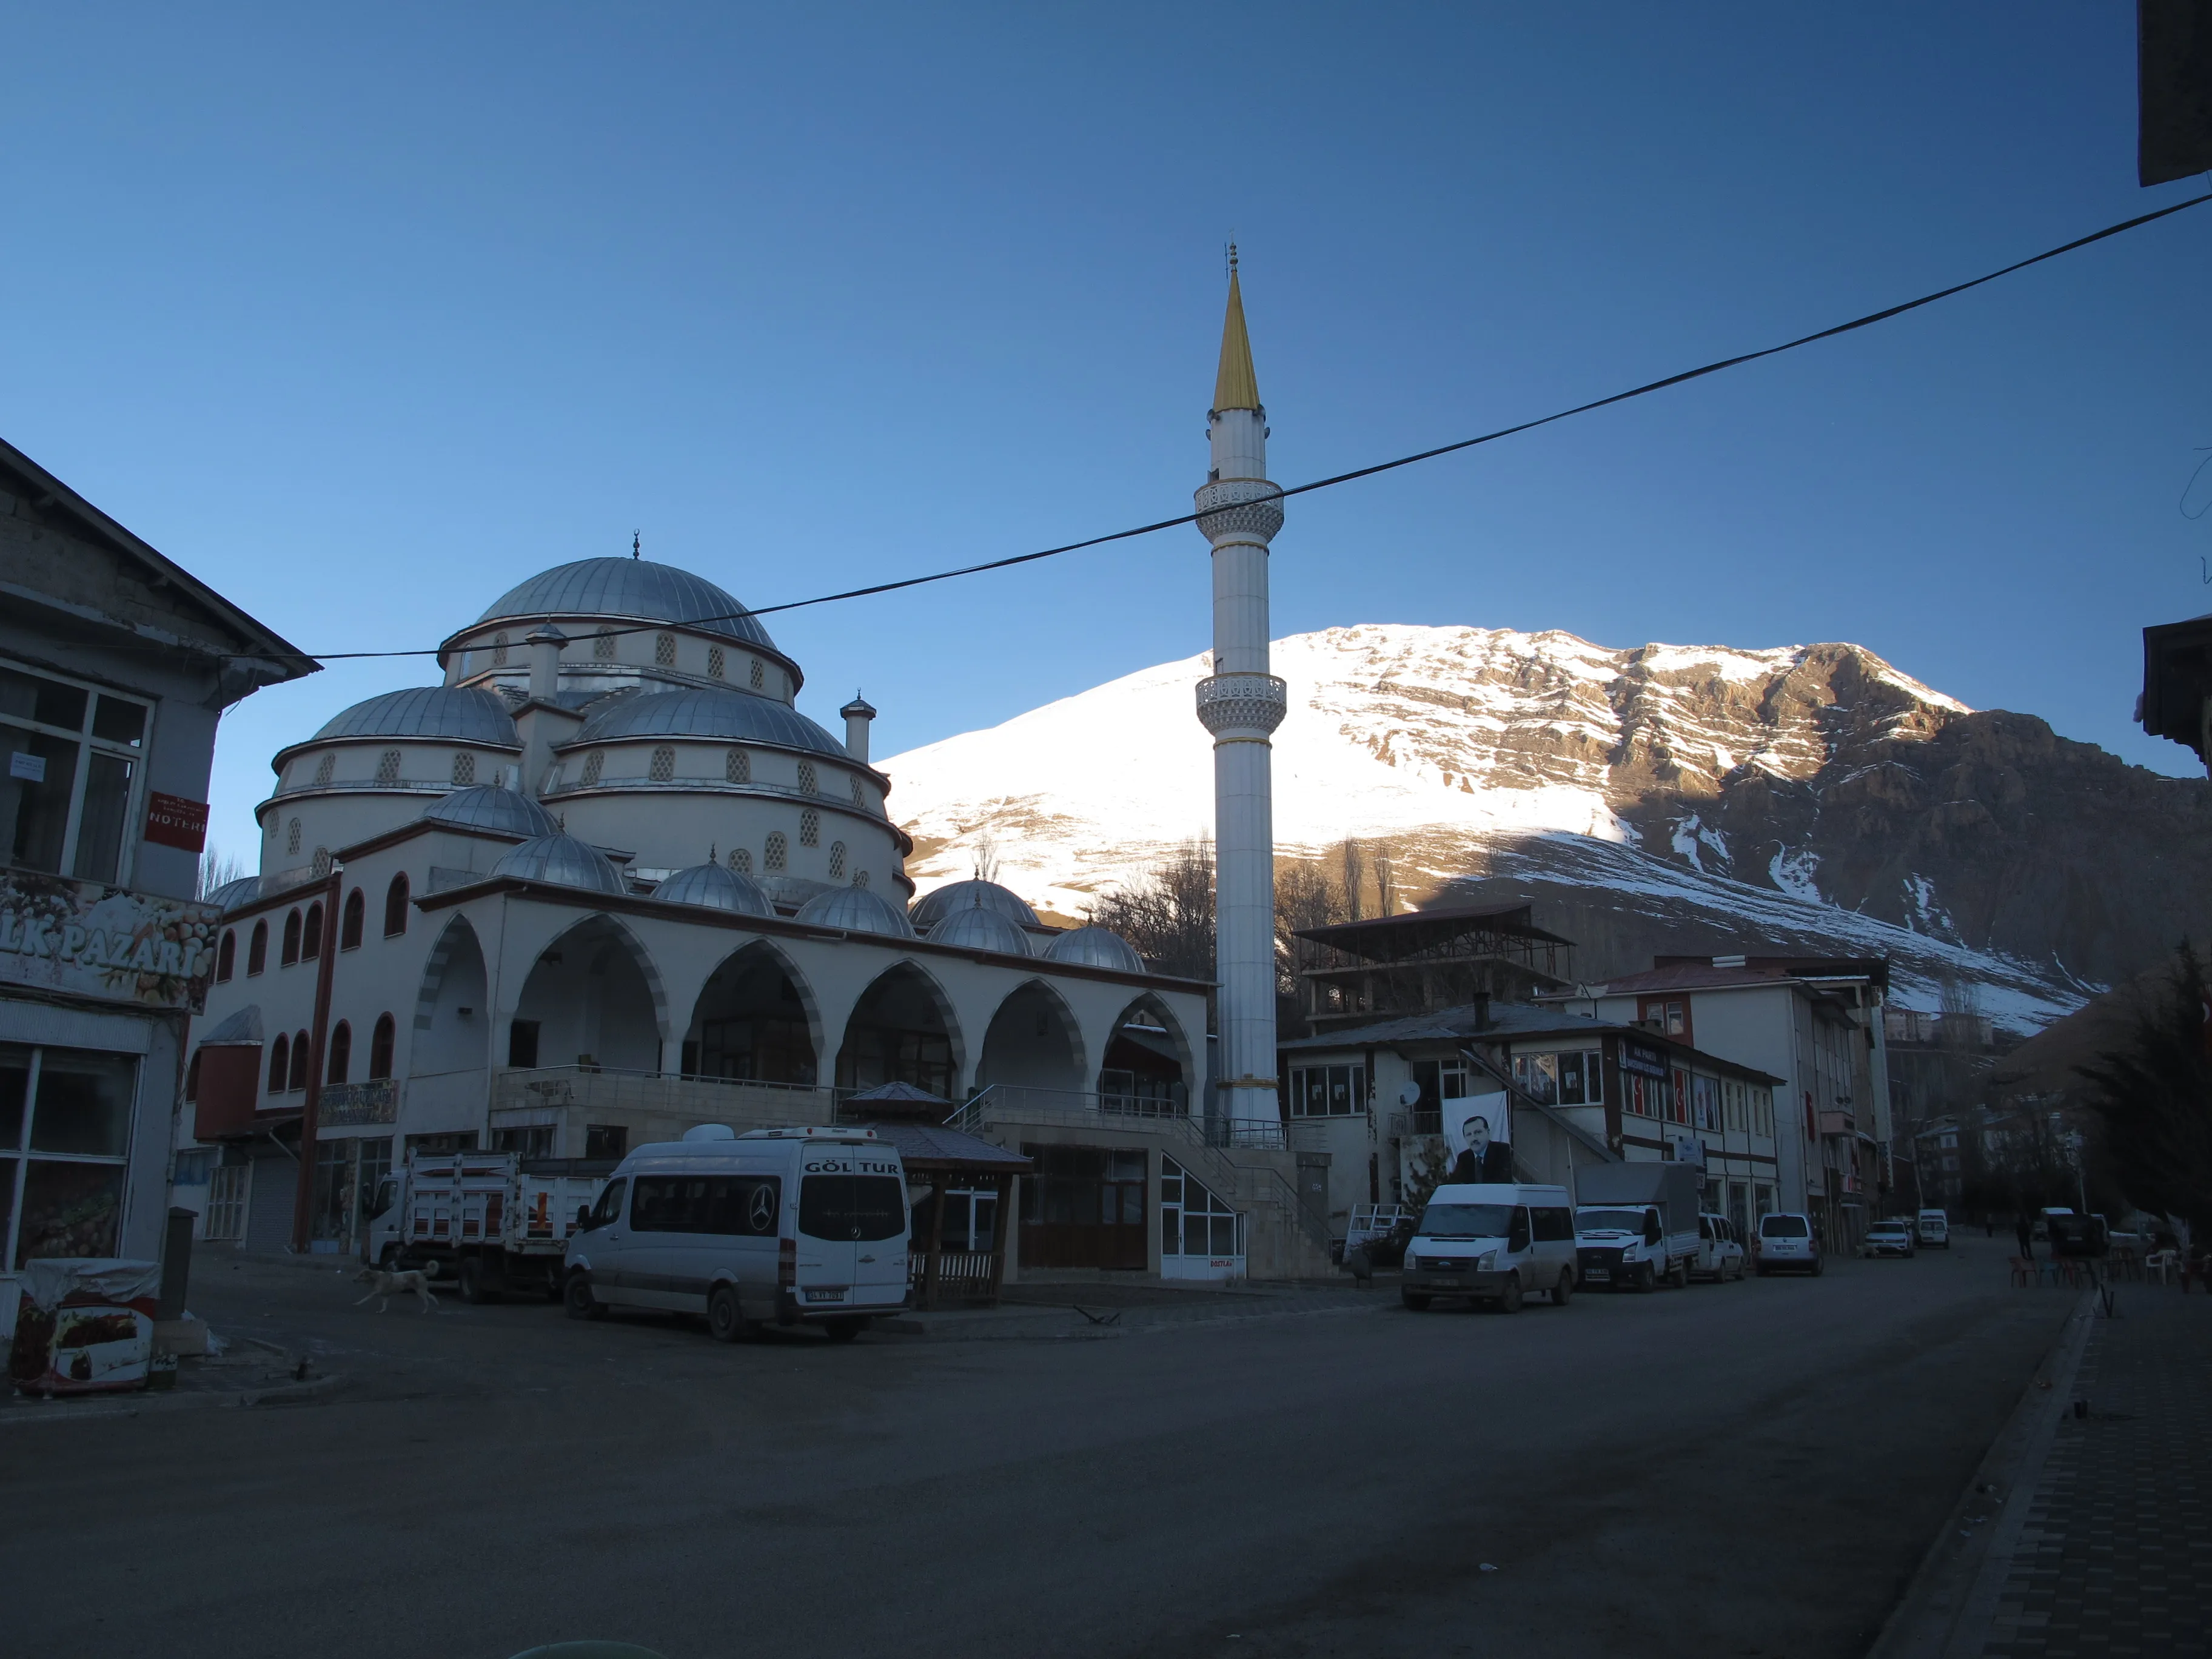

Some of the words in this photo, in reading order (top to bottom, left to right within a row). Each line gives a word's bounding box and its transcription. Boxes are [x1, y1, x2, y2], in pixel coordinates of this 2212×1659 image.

[150, 812, 206, 833] NOTERİ
[60, 925, 196, 979] PAZARI
[805, 1159, 852, 1173] GÖL
[859, 1162, 899, 1174] TUR
